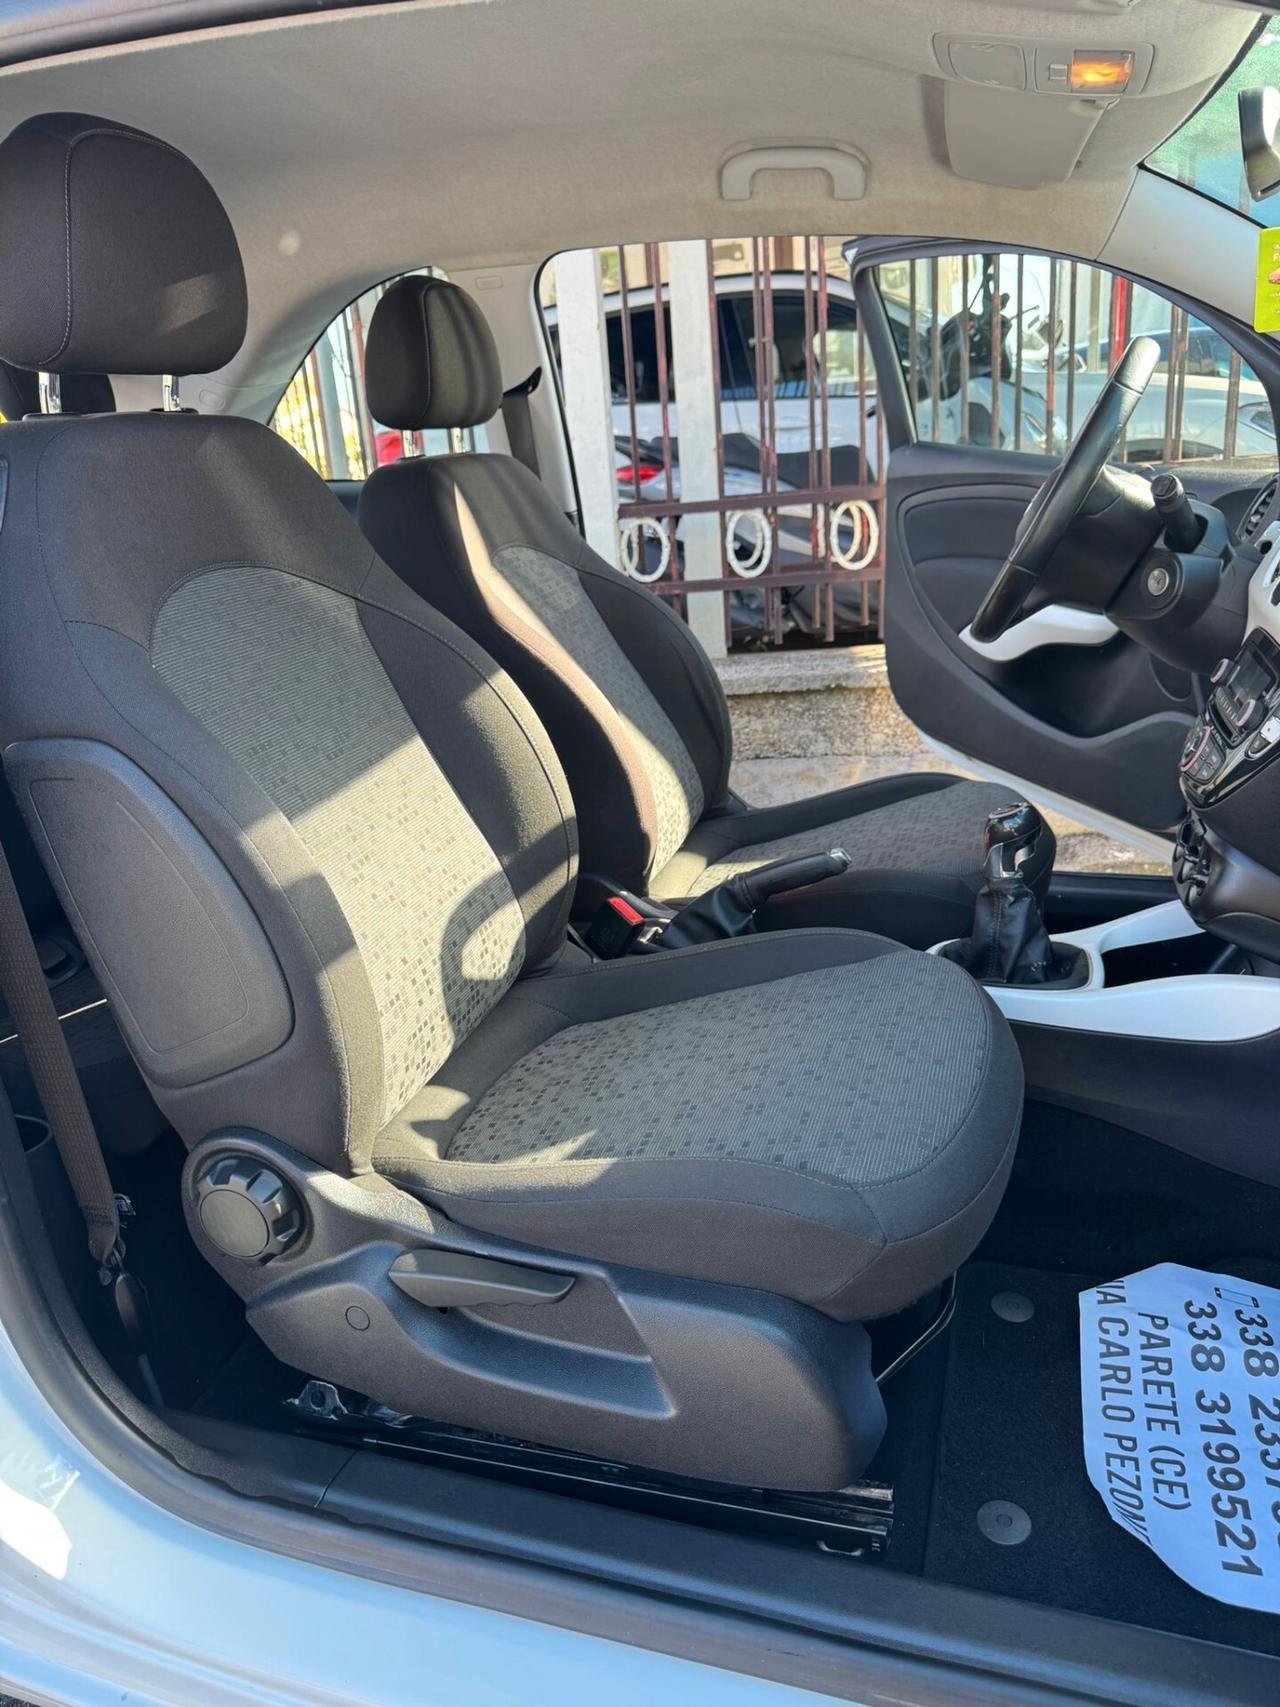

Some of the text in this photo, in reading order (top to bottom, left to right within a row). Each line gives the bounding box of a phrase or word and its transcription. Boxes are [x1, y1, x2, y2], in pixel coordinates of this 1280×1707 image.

[1098, 1316, 1135, 1422] CARLO
[1138, 1312, 1192, 1510] PARETE (CE)
[1235, 1309, 1279, 1377] 338
[1184, 1300, 1264, 1577] 338 3199521
